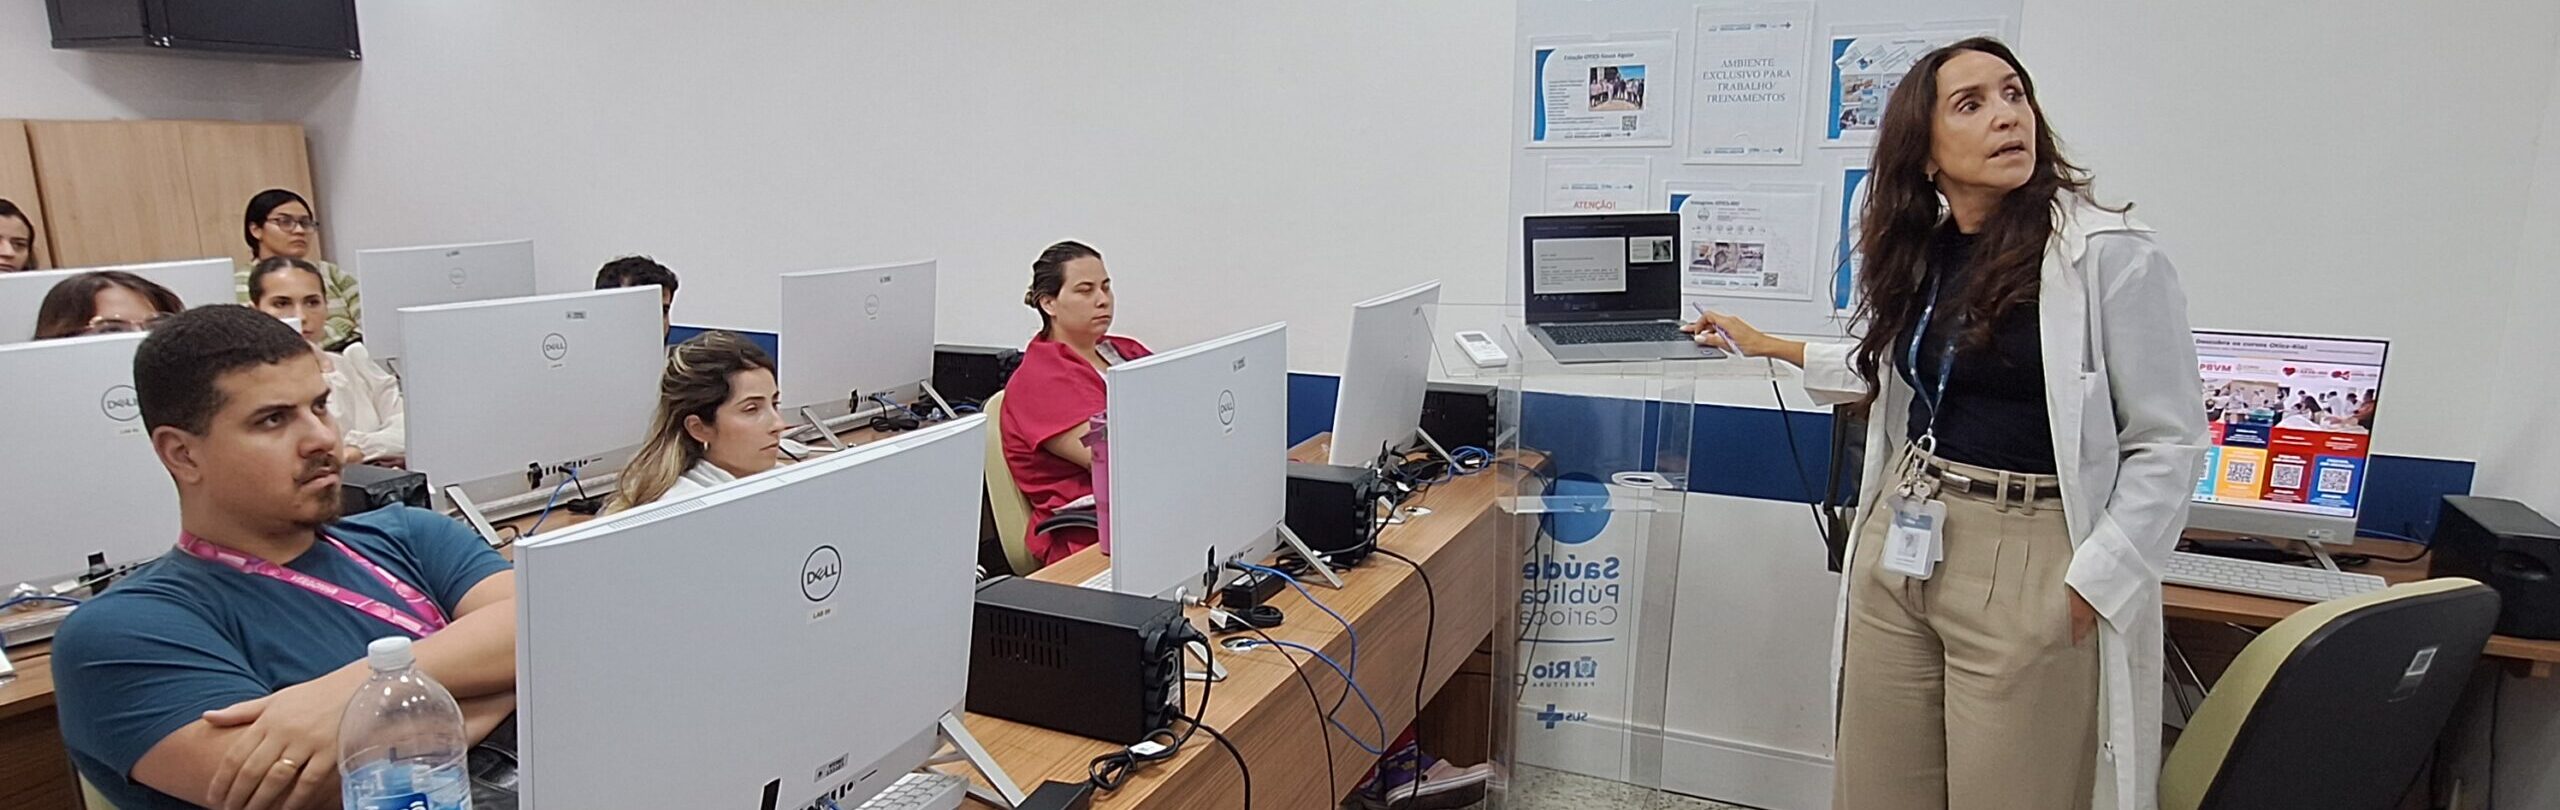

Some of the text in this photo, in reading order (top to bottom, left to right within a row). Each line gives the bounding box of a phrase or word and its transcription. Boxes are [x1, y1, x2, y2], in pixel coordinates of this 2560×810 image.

[1721, 58, 1775, 68] AMBIENTE
[1703, 69, 1791, 80] EXCLUSIVO PARA
[1706, 93, 1786, 103] TREINAMENTOS
[1573, 200, 1616, 210] ATENÇÃO!
[806, 563, 838, 585] DELL
